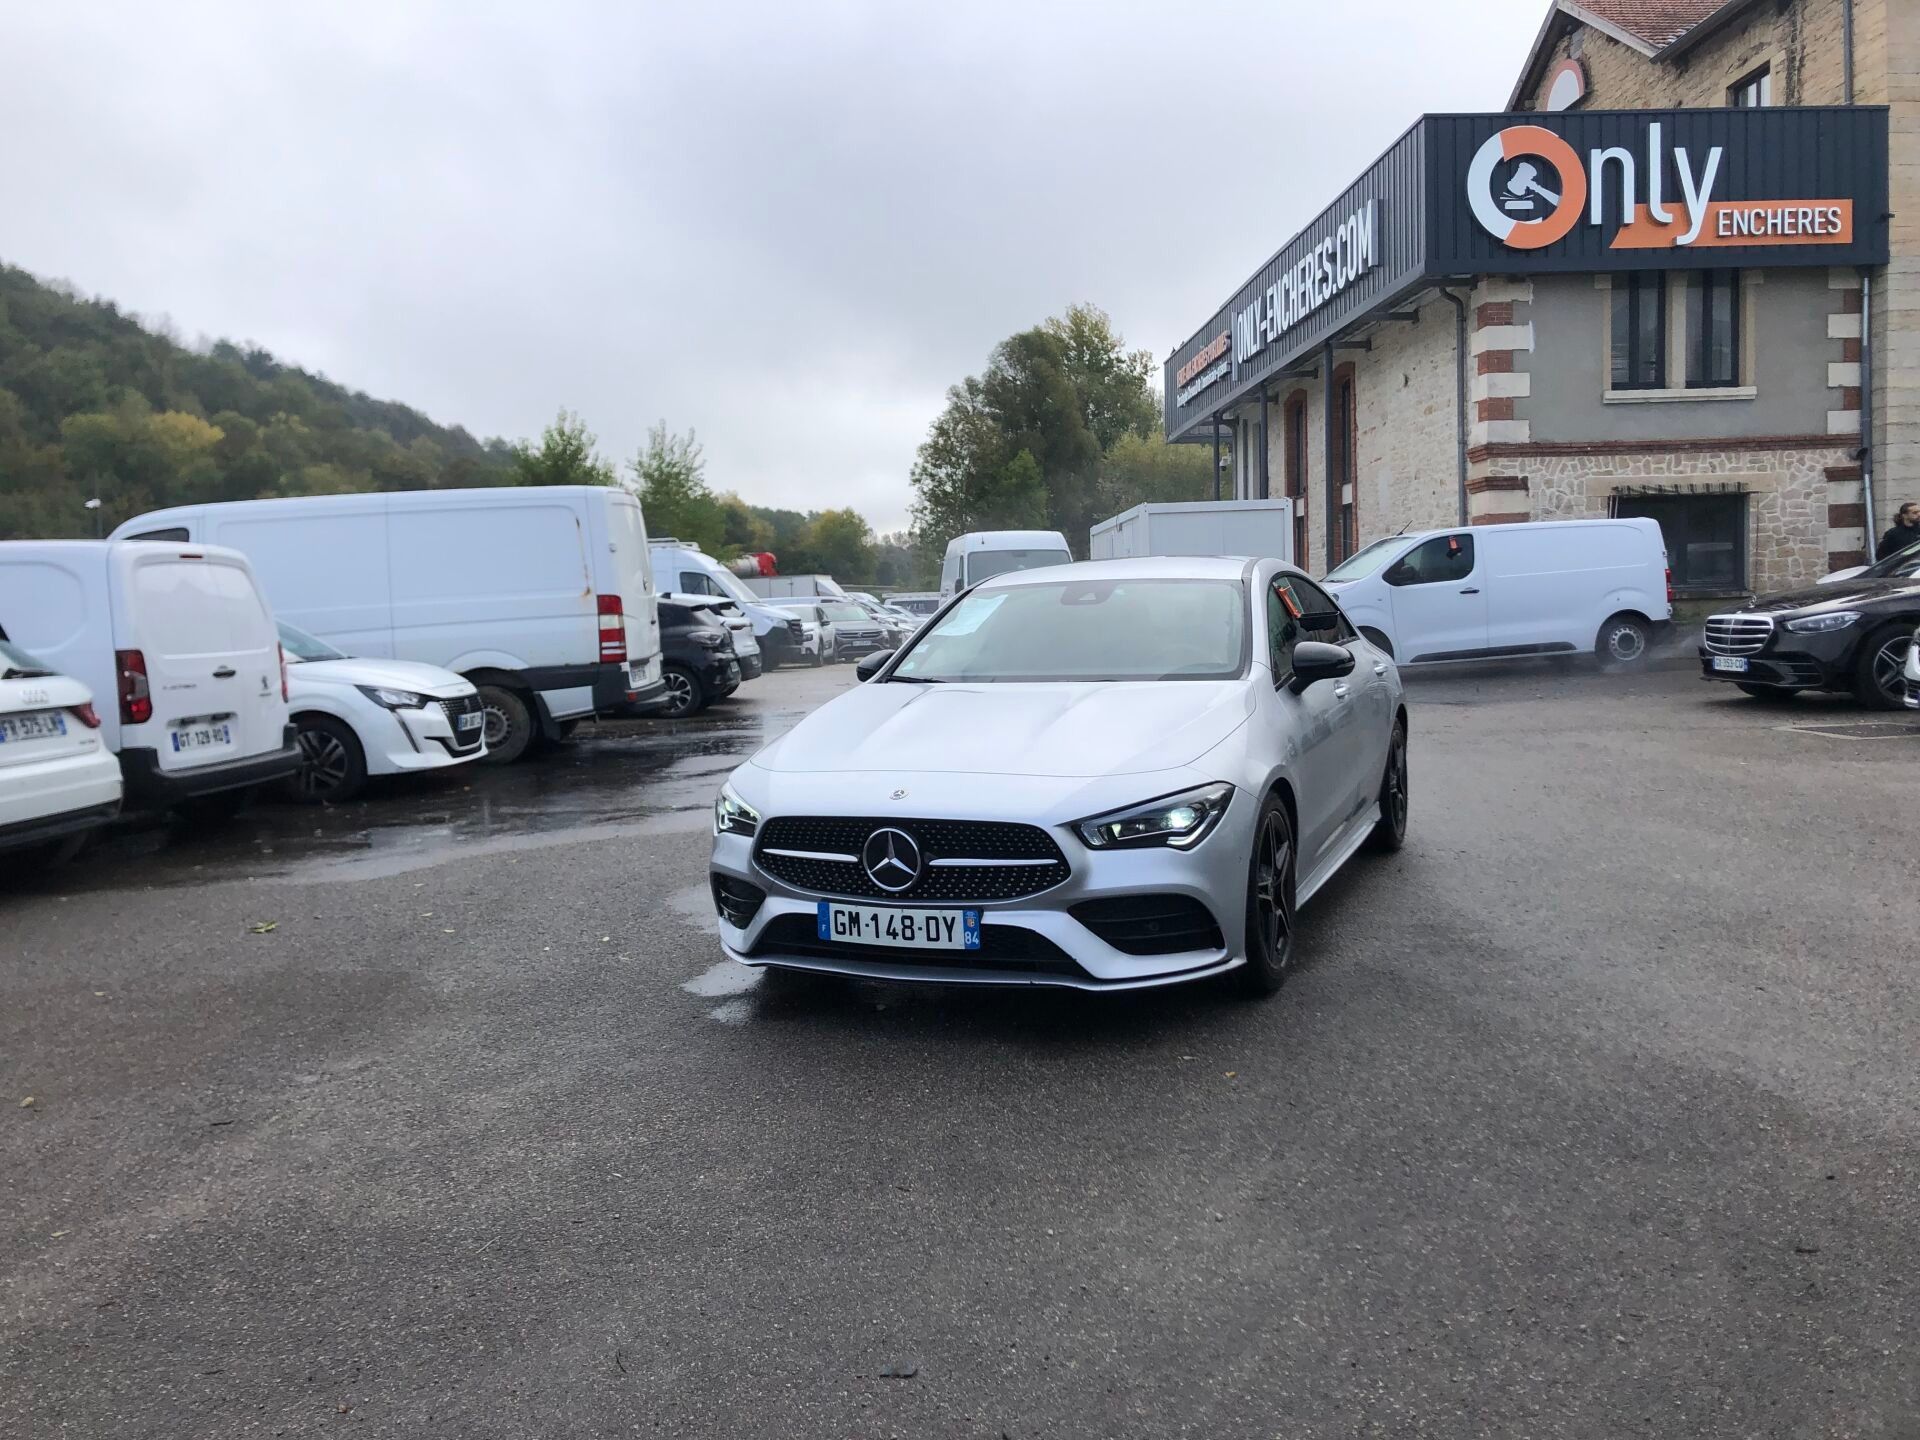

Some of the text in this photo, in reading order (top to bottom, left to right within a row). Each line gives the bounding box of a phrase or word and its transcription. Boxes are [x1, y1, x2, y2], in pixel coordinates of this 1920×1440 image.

[1467, 122, 1723, 249] Only
[1717, 207, 1843, 238] ENCHERES
[1237, 198, 1373, 365] ONLY-ENCHERES.COM
[833, 909, 957, 943] GM-148-DY
[964, 931, 980, 945] 84
